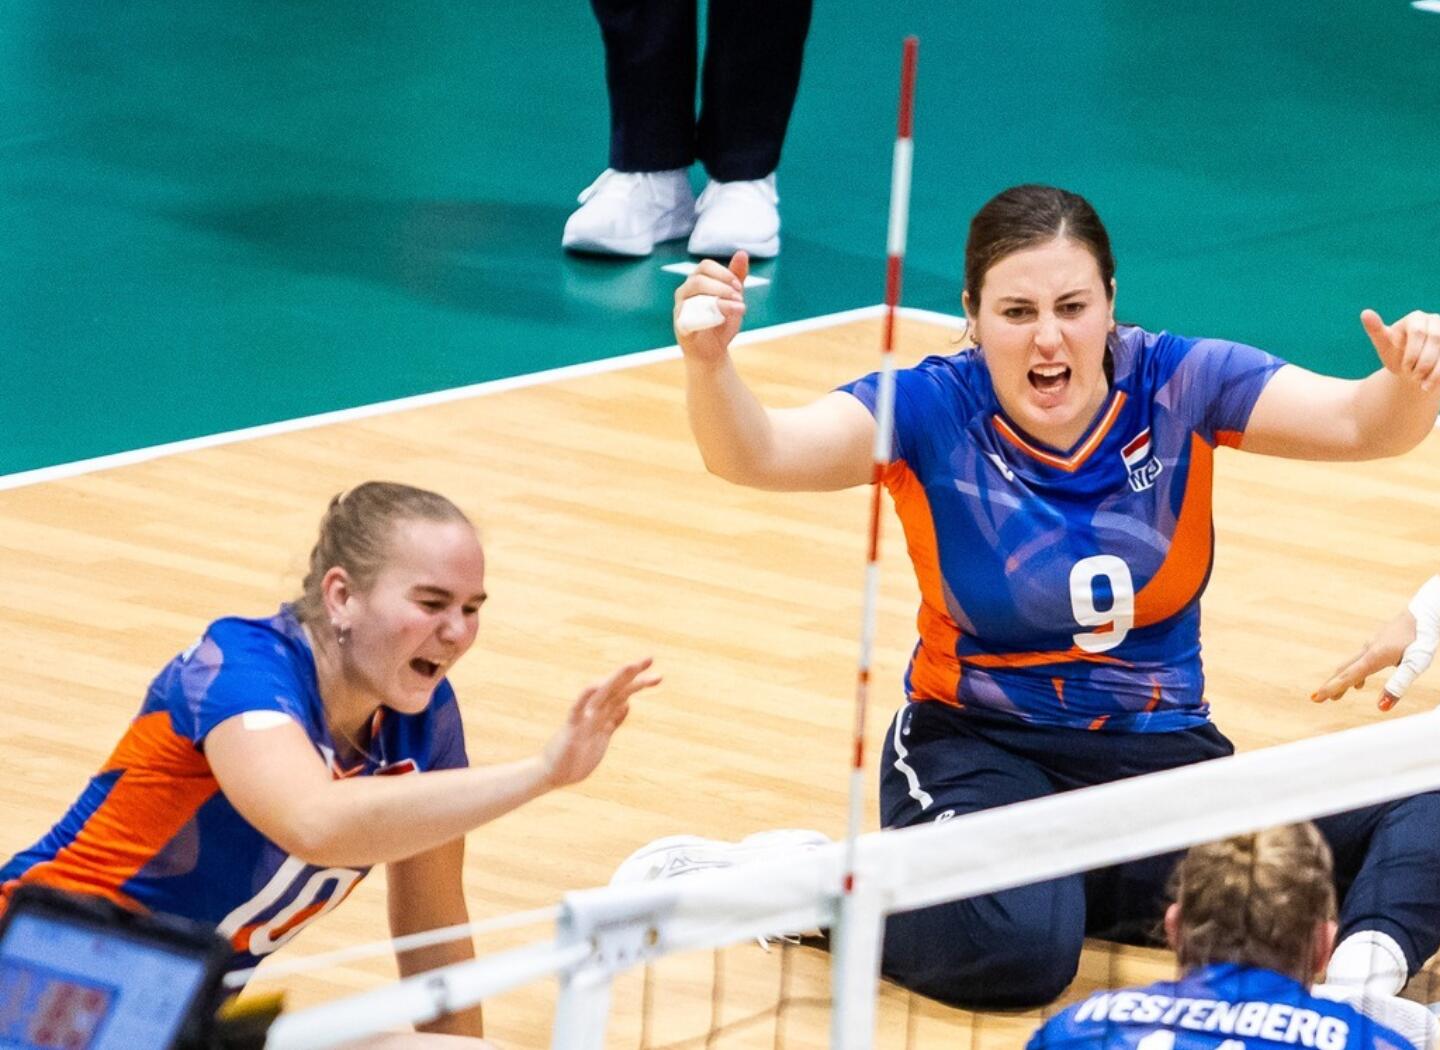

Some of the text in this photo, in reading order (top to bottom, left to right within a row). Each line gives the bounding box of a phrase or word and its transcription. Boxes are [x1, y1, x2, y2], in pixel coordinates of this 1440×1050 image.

[1069, 554, 1136, 654] 9
[215, 855, 361, 957] 10
[1074, 990, 1350, 1050] WESTENBERG
